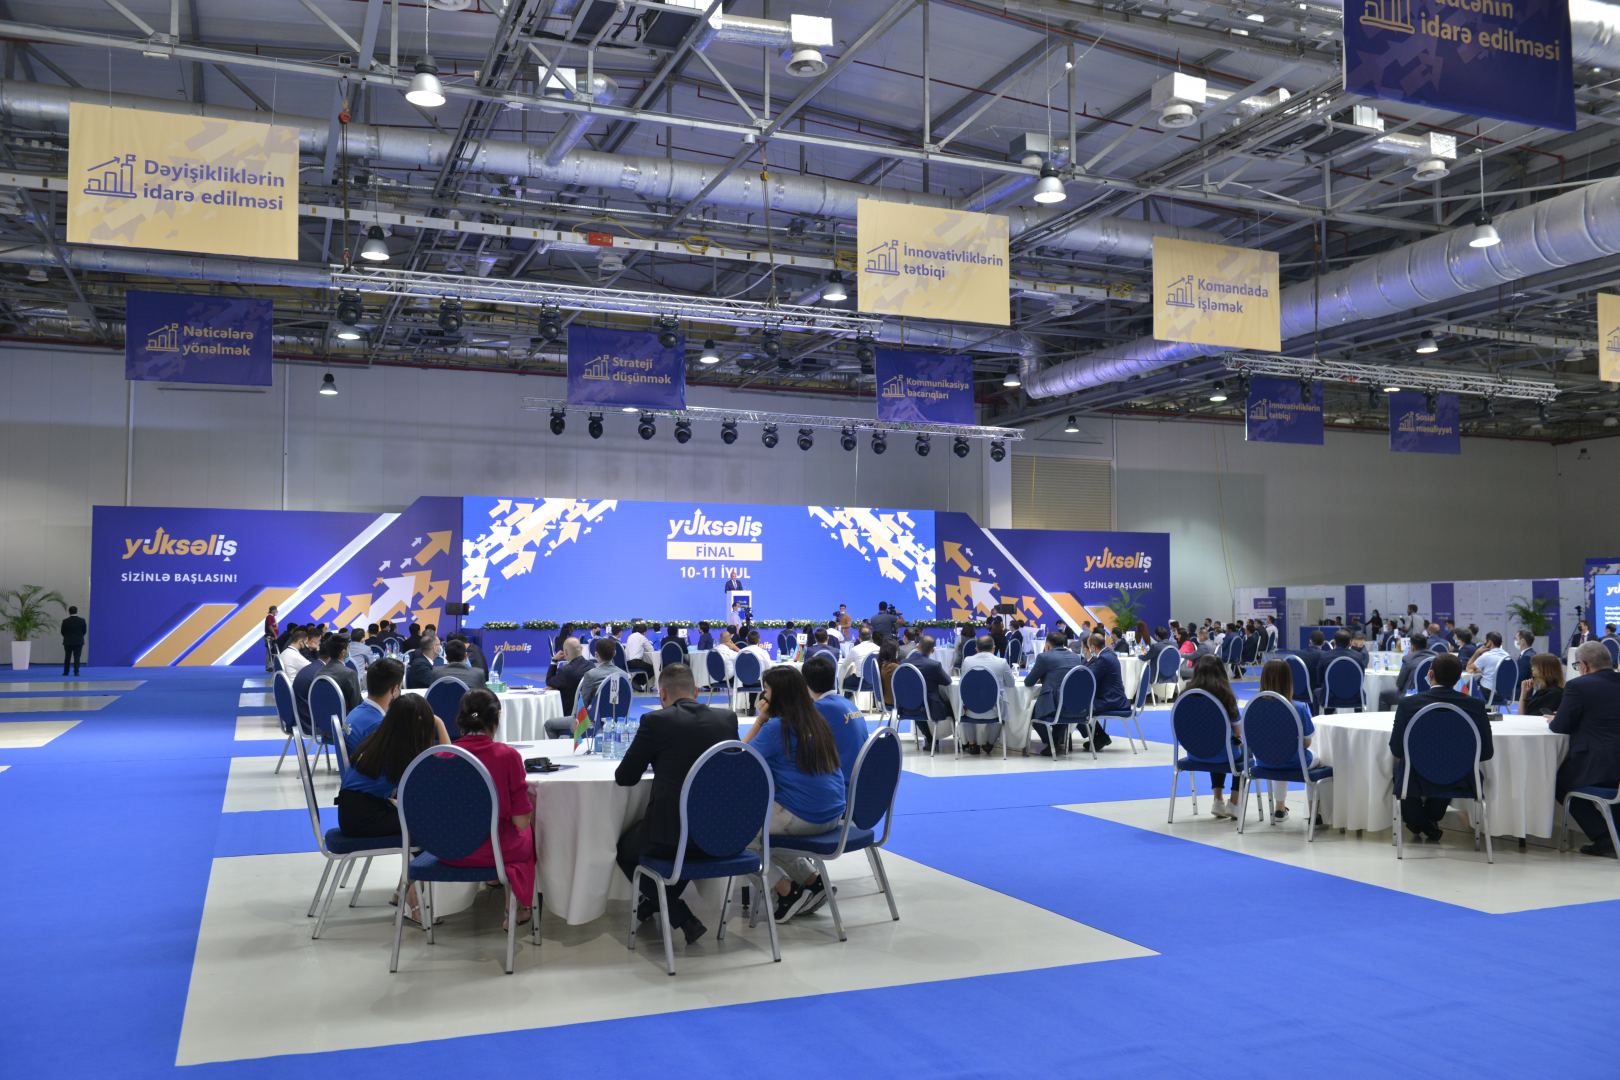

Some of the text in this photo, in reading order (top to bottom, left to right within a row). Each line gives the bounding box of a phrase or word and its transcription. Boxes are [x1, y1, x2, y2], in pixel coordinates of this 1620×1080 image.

[1420, 12, 1560, 61] idarə edilməsi
[144, 159, 285, 187] Dəyişikliklərin
[143, 183, 283, 210] idarə edilməsi
[903, 241, 1003, 267] İnnovativliklərin
[903, 263, 945, 280] tətbiqi
[1197, 278, 1269, 298] Komandada
[1197, 296, 1244, 313] işləmək
[183, 325, 254, 340] Nəticələrə
[182, 342, 251, 356] yönəlmək
[612, 356, 653, 371] Strateji
[612, 372, 672, 385] düşünmək
[906, 377, 970, 391] Kommunikasiya
[696, 543, 735, 558] FİNAL
[121, 571, 238, 585] SİZİNLƏ BAŞLASIN!
[680, 564, 751, 579] 10-11 İYUL
[1083, 580, 1114, 589] SİZİNLƏ
